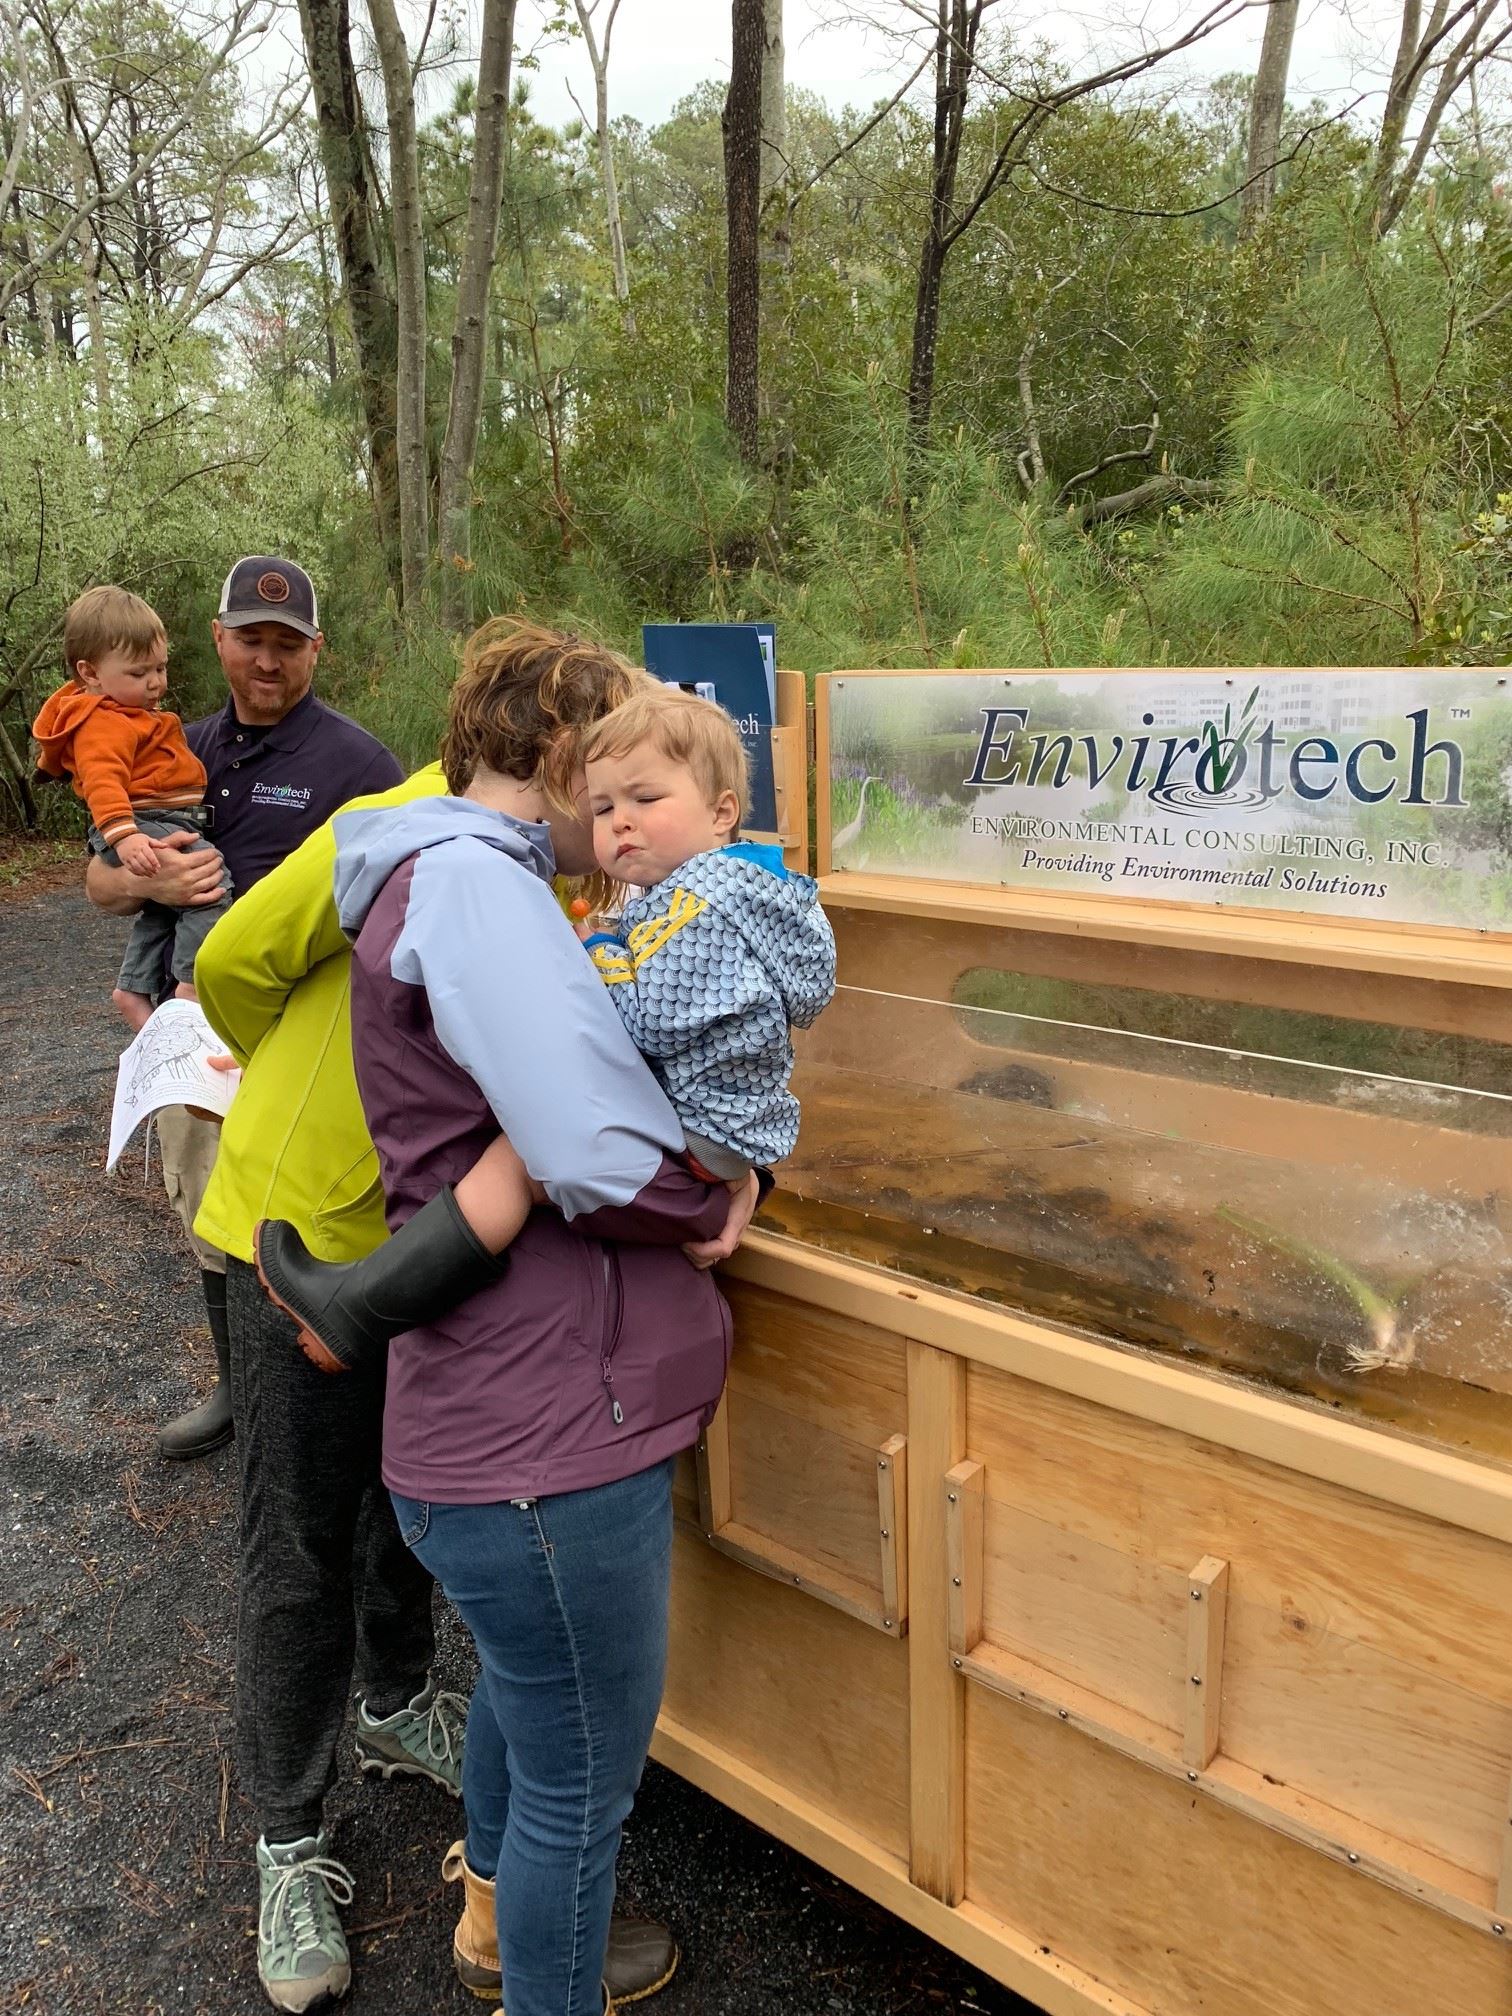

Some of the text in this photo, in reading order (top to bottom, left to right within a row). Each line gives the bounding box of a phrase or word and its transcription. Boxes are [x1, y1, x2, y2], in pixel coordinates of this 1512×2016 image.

[964, 707, 1469, 806] Envirotech
[251, 782, 311, 799] Envirotech
[971, 816, 1449, 867] ENVIRONMENTAL CONSULTING, INC.
[1021, 849, 1388, 898] Providing Environmental Solutions
